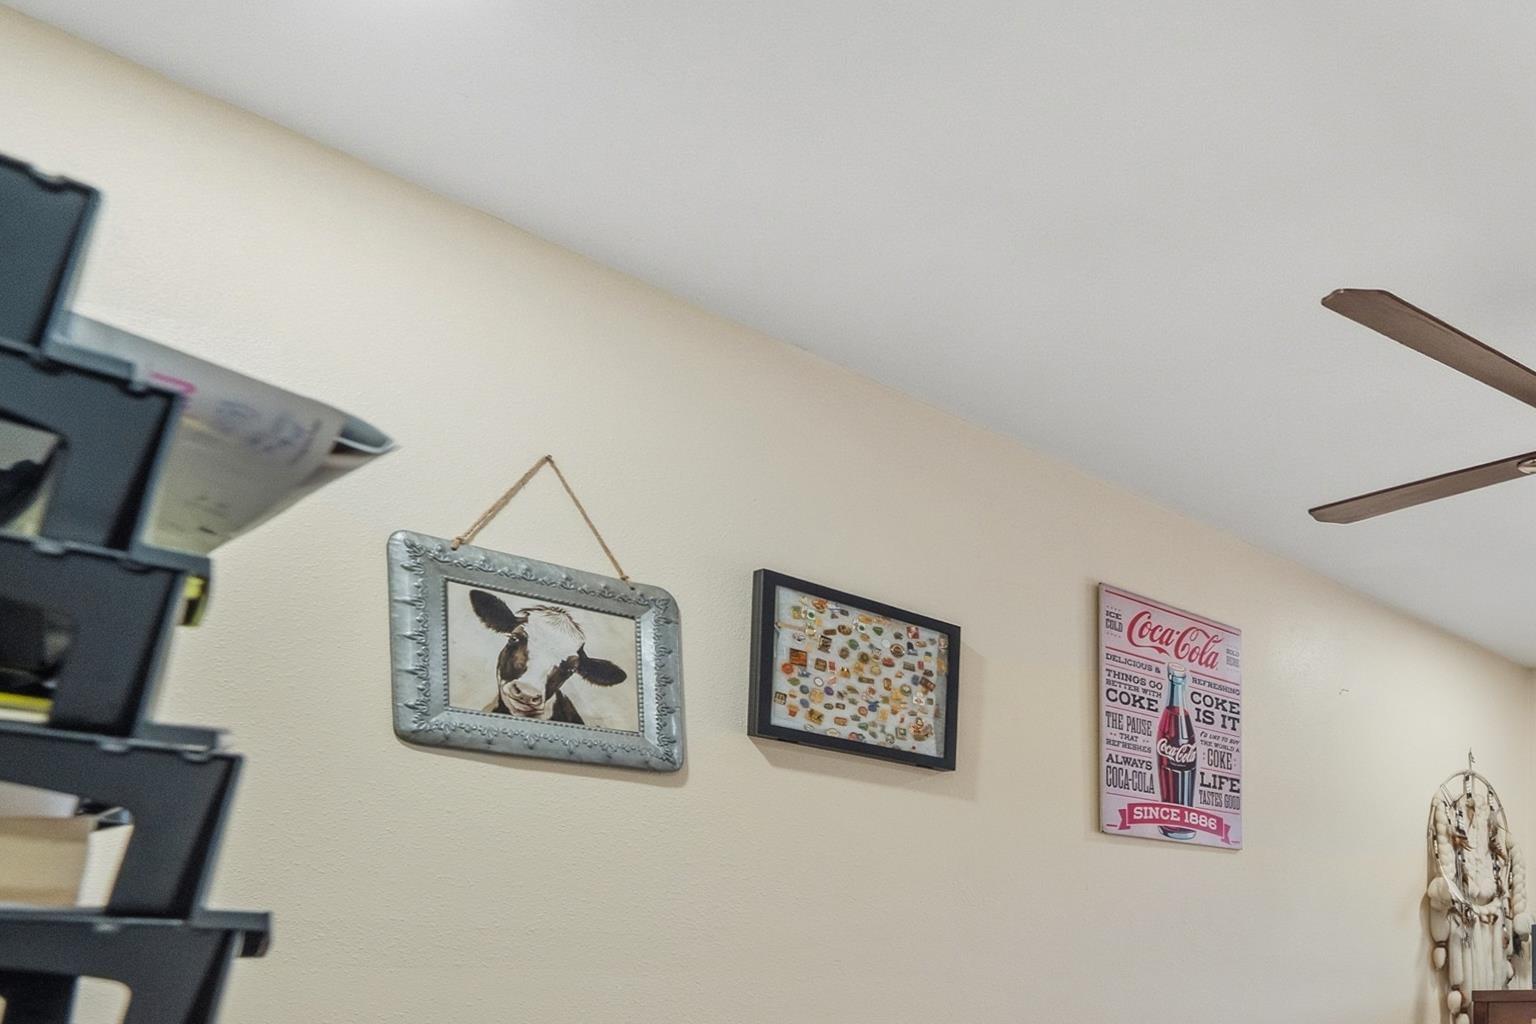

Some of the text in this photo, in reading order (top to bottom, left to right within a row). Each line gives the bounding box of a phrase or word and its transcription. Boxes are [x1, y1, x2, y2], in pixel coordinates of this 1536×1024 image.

[1105, 611, 1122, 620] ICE
[1105, 618, 1123, 632] COLD
[1127, 611, 1223, 670] Coca-Cola
[1105, 653, 1153, 672] DELICIOUS
[1105, 669, 1163, 690] THINGS GO
[1105, 678, 1162, 699] BETTER WITH
[1191, 676, 1240, 696] REFRESHING
[1105, 688, 1159, 712] COKE
[1190, 691, 1240, 715] COKE
[1105, 711, 1152, 737] THE PAUSE
[1194, 708, 1240, 731] IS IT
[1105, 738, 1152, 754] REFRESHES
[1119, 733, 1139, 743] THAT
[1200, 739, 1213, 747] THE
[1213, 742, 1235, 752] WORLD
[1105, 753, 1153, 771] ALWAYS
[1207, 748, 1233, 771] COKE
[1105, 766, 1155, 794] COCA-COLA
[1199, 771, 1240, 793] LIFE
[1199, 789, 1240, 810] TASTES GOOD
[1133, 806, 1217, 830] SINCE 1886
